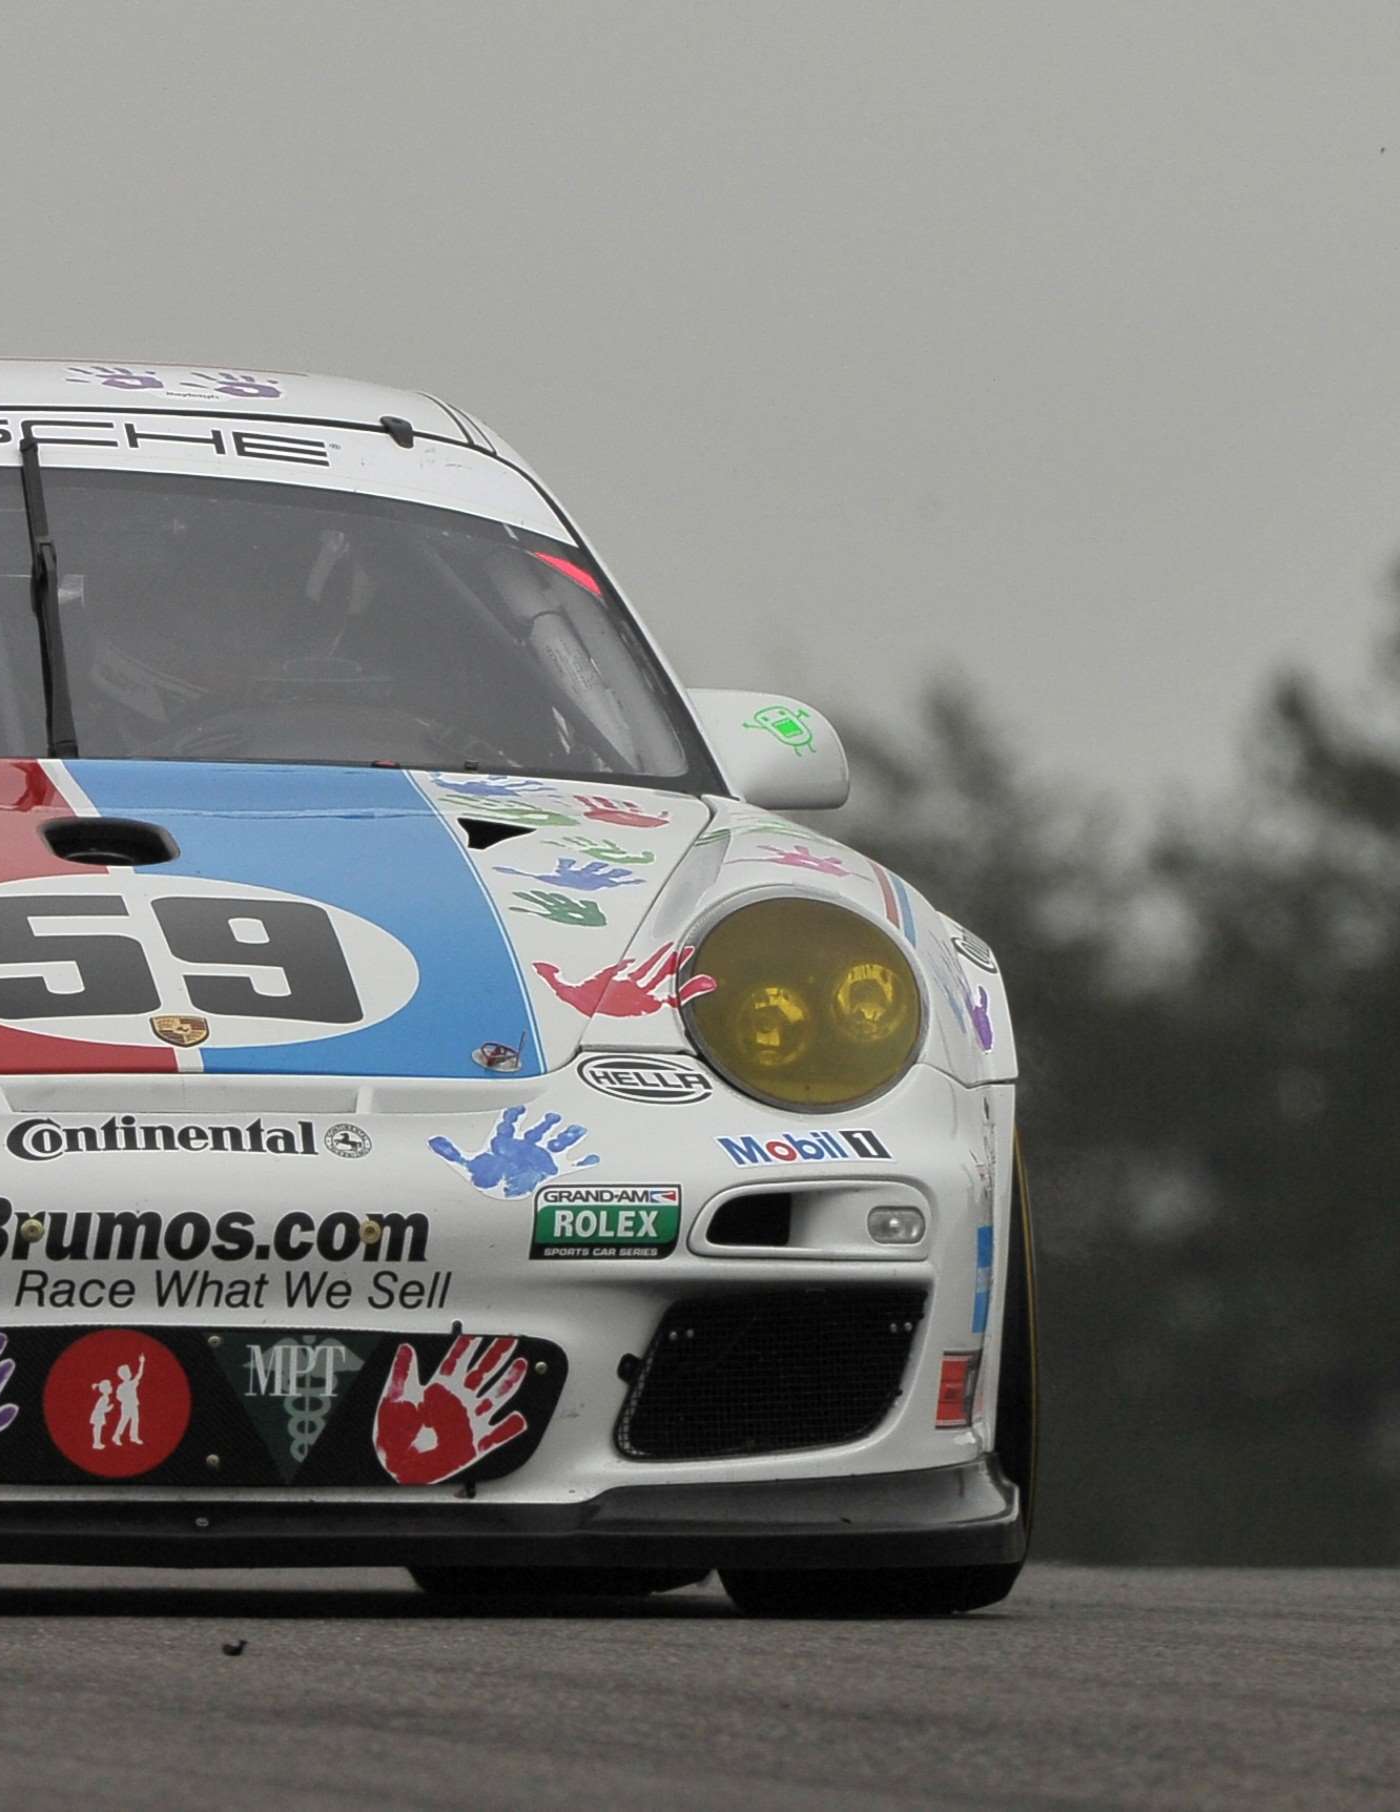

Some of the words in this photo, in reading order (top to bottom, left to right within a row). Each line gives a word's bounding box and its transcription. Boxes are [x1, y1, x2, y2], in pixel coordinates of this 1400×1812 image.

[589, 1067, 712, 1092] HELLA
[7, 1115, 320, 1160] Continental
[719, 1130, 846, 1166] Mobil
[553, 1210, 658, 1238] ROLEX
[544, 1248, 589, 1256] SPORTS
[593, 1248, 616, 1256] CAR
[619, 1248, 657, 1256] SERIES
[14, 1270, 136, 1308] Race
[154, 1269, 271, 1308] What
[284, 1270, 352, 1308] We
[367, 1271, 452, 1309] Sell
[244, 1343, 346, 1397] MPT
